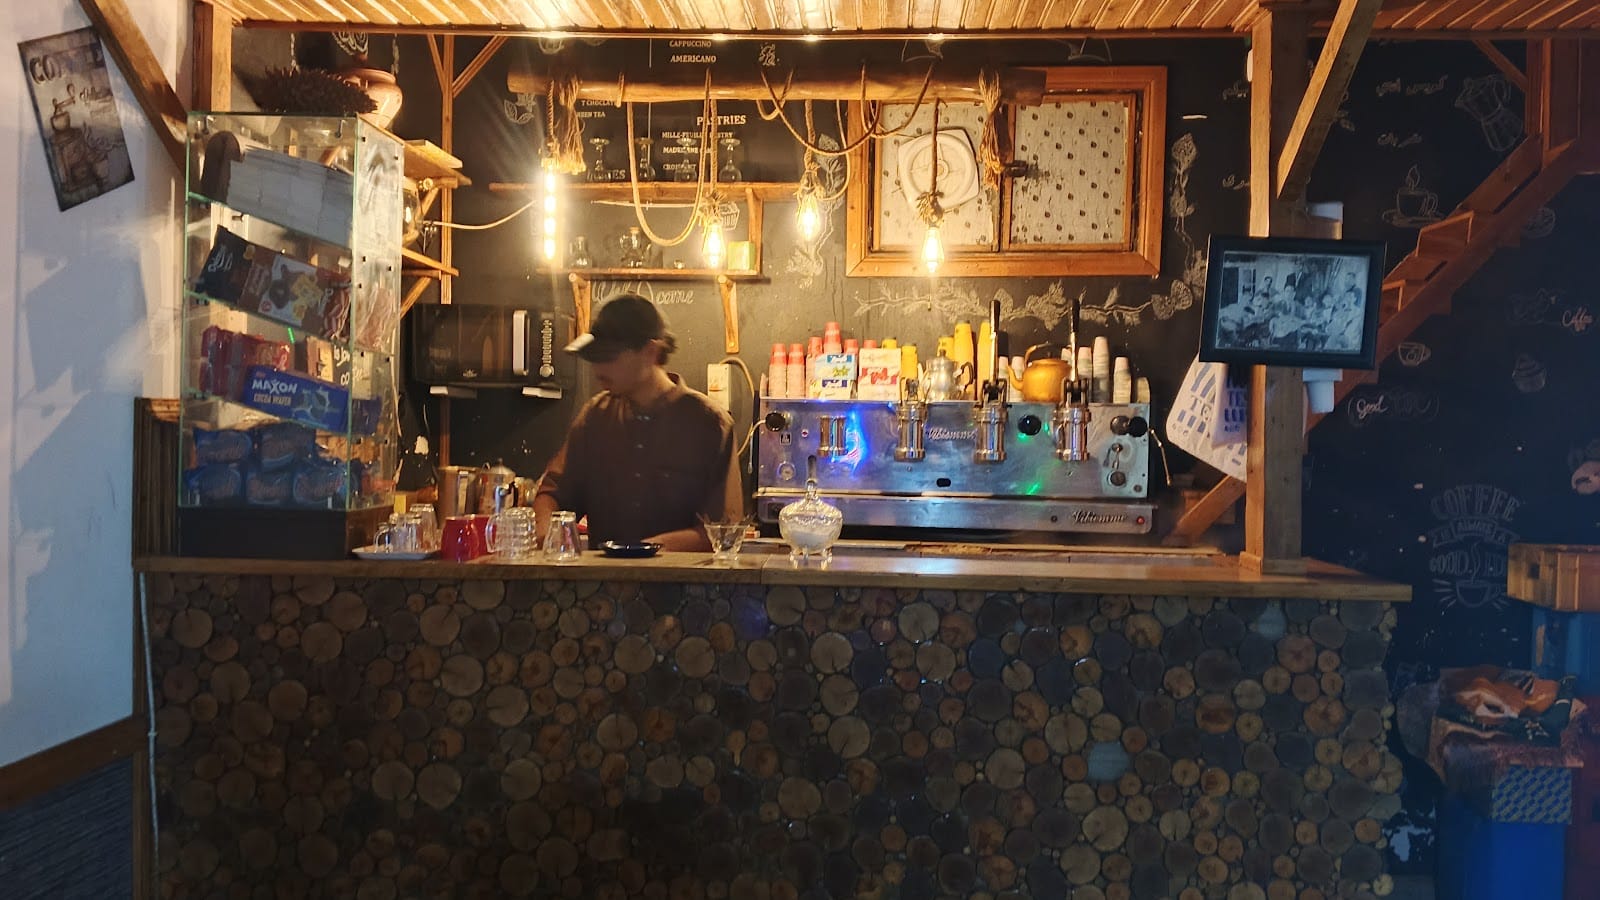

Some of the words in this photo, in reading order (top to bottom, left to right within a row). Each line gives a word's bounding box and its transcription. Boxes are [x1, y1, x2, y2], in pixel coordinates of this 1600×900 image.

[669, 40, 712, 48] CAPPUCCINO
[670, 55, 717, 63] AMERICANO
[251, 378, 298, 395] MAXON
[1431, 484, 1520, 522] COFFEE
